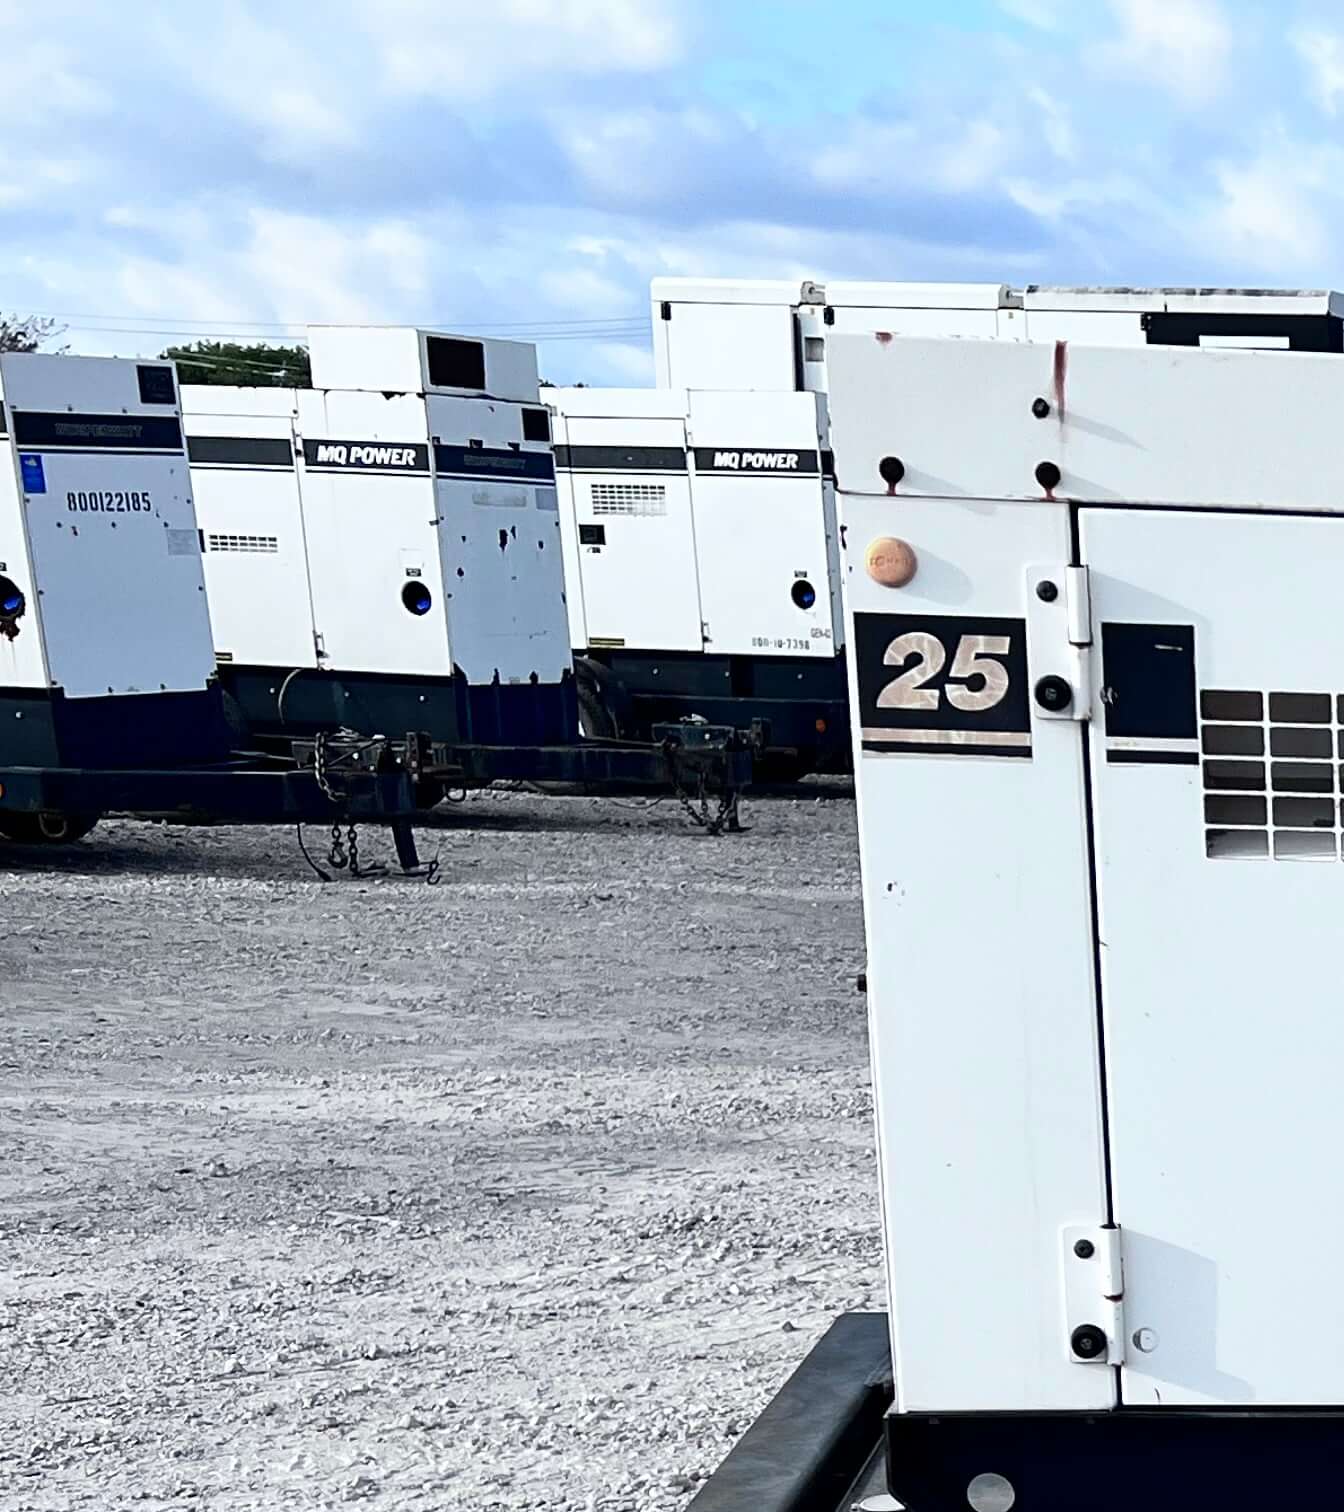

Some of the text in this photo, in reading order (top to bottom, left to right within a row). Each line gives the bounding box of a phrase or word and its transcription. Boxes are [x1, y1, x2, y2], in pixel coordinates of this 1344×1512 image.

[316, 444, 417, 466] MQ POWER
[713, 451, 799, 469] MQ POWER
[67, 491, 151, 513] 800122185
[876, 631, 1011, 712] 25
